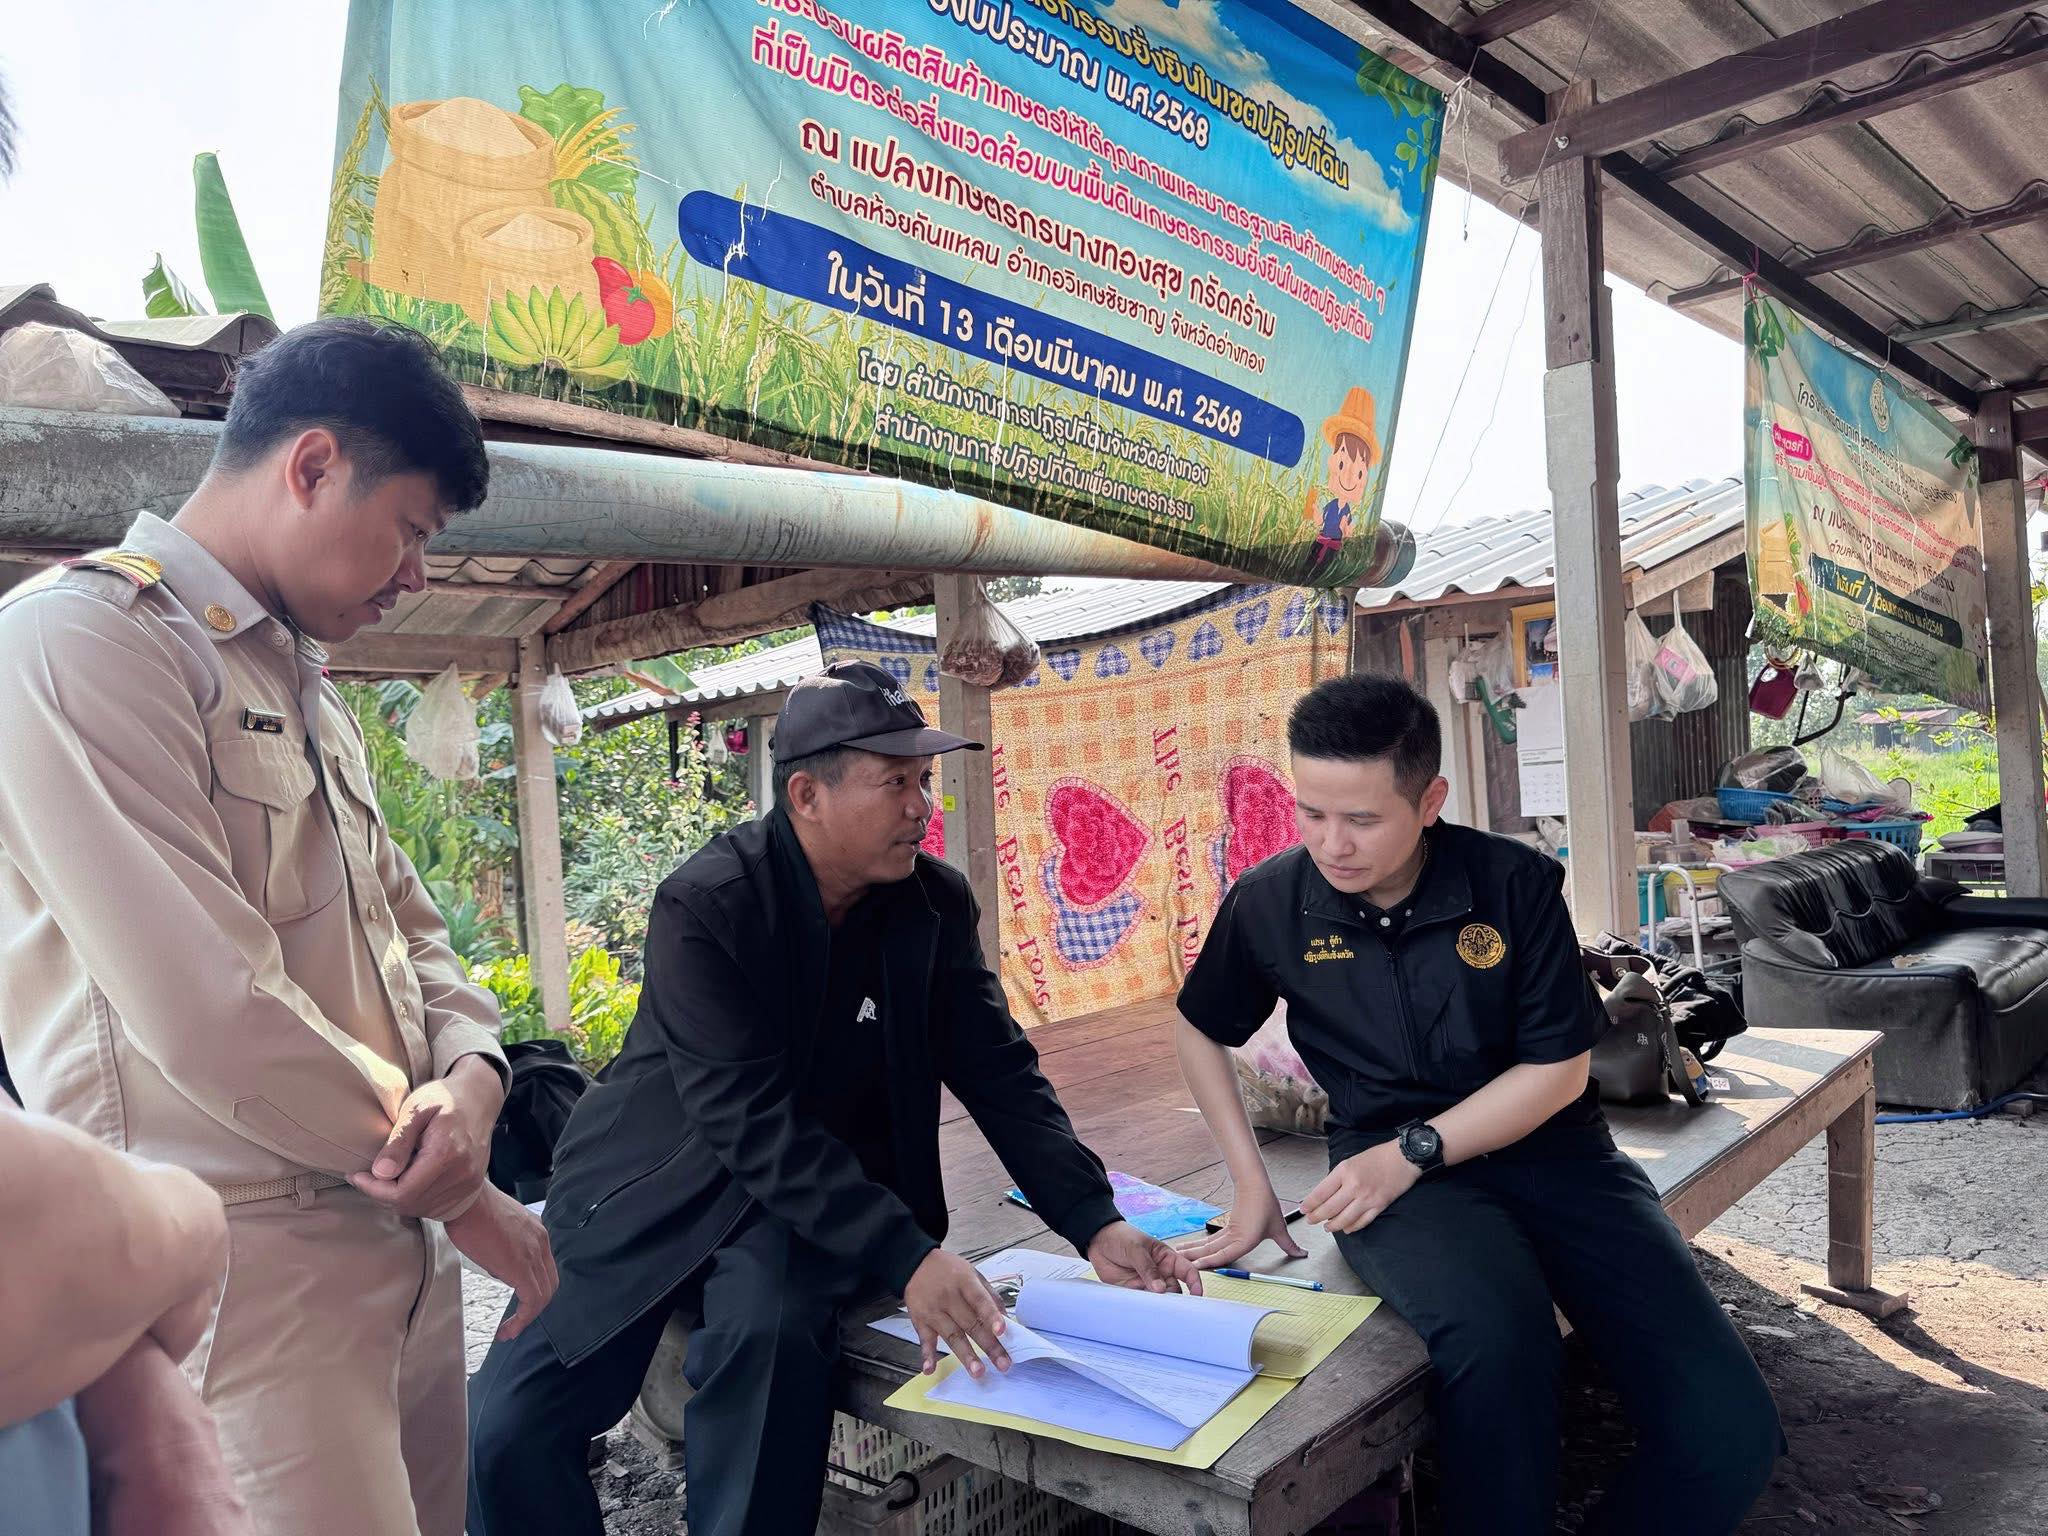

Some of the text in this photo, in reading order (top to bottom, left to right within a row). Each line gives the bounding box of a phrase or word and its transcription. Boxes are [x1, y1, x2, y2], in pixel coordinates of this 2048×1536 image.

[1105, 66, 1210, 150] พ.ศ.2568
[800, 120, 840, 162] ณ
[850, 136, 1184, 302] แปลงเกษตรกรนางทองสุข
[809, 170, 1266, 375] ตำบลห้วยคันแหลน อำเภอวิเศษชัยชาญ จังหวัดอ่างทอง
[827, 250, 1243, 440] ในวันที่ 13 เดือนมีนาคม พ.ศ. 2568
[858, 347, 900, 388] โดย
[874, 404, 1195, 523] สำนักงานการปฏิรูปที่ดินเพื่อเกษตรกรรม
